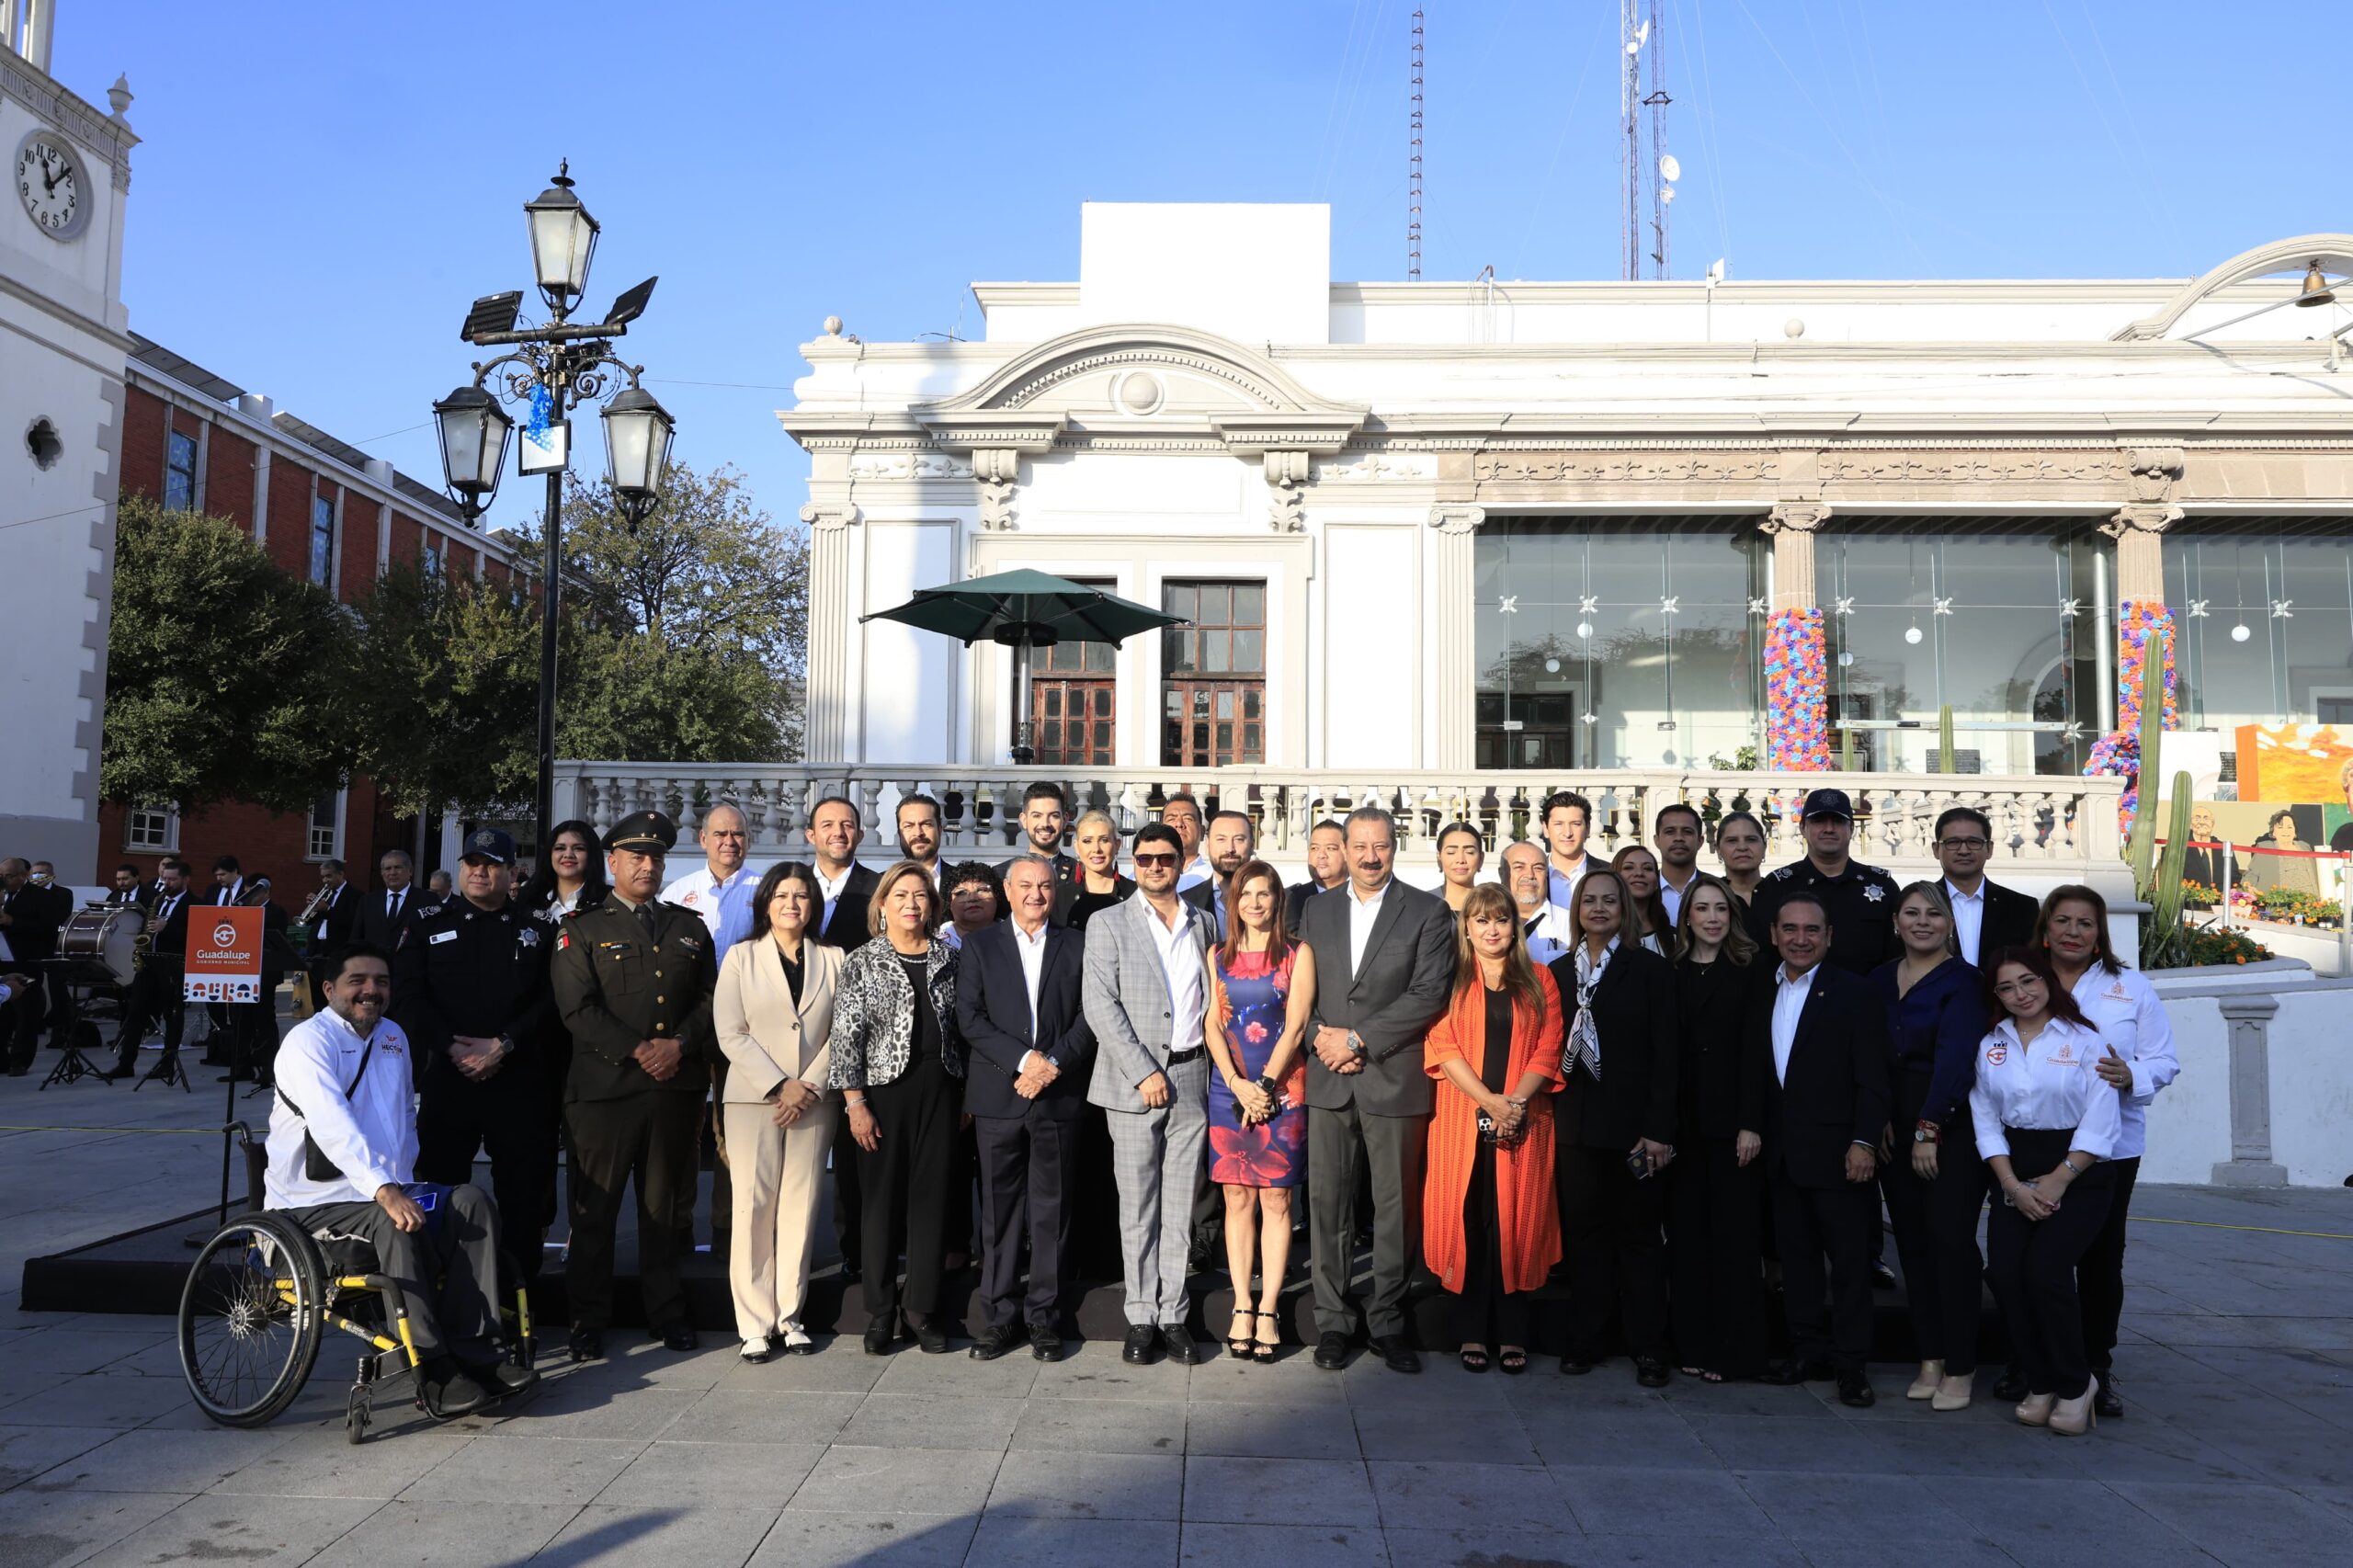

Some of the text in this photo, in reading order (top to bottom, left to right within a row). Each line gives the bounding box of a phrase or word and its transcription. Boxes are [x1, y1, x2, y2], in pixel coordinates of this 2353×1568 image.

[24, 149, 35, 165] 10
[36, 143, 43, 159] 11
[47, 148, 57, 163] 12
[19, 161, 26, 176] 9
[65, 174, 73, 188] 2
[22, 182, 29, 197] 8
[30, 199, 39, 212] 7
[68, 194, 75, 208] 3
[40, 210, 48, 225] 6
[52, 214, 59, 227] 5
[62, 209, 68, 222] 4
[197, 949, 251, 960] Guadalupe
